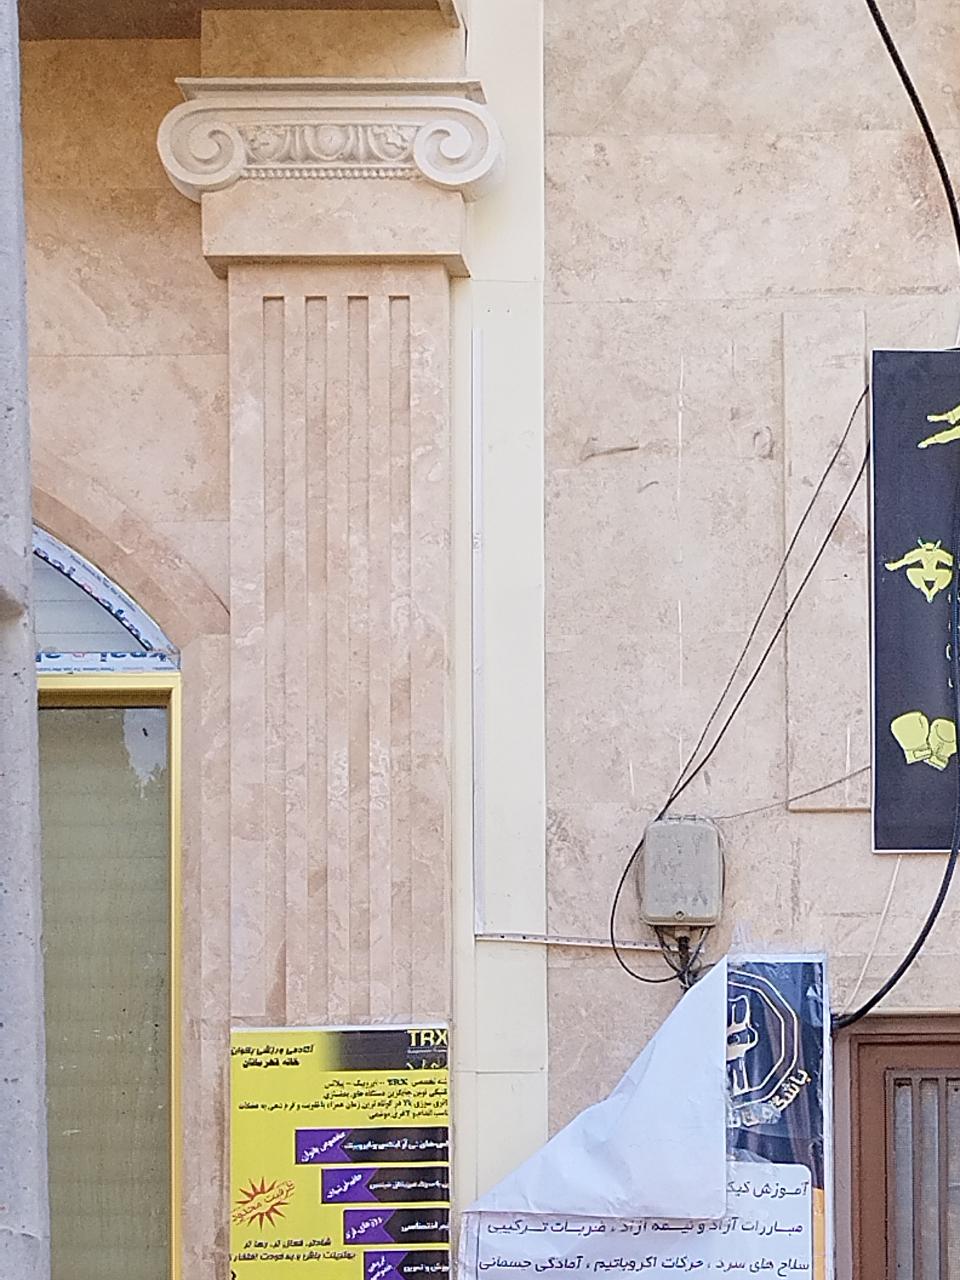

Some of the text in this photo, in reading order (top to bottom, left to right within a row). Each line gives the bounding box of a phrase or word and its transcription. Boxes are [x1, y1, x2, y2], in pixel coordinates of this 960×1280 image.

[406, 1029, 448, 1047] TRX
[753, 1181, 809, 1198] آموزش
[488, 1219, 549, 1235] ترکیبی
[551, 1220, 606, 1236] ضربات
[651, 1221, 693, 1235] نیمه
[696, 1222, 705, 1235] و
[708, 1217, 739, 1234] آزاد
[535, 1256, 584, 1273] آمادگی
[661, 1256, 704, 1272] حرکات
[716, 1259, 746, 1273] سرد
[750, 1258, 774, 1272] های
[777, 1258, 809, 1277] سلاح
